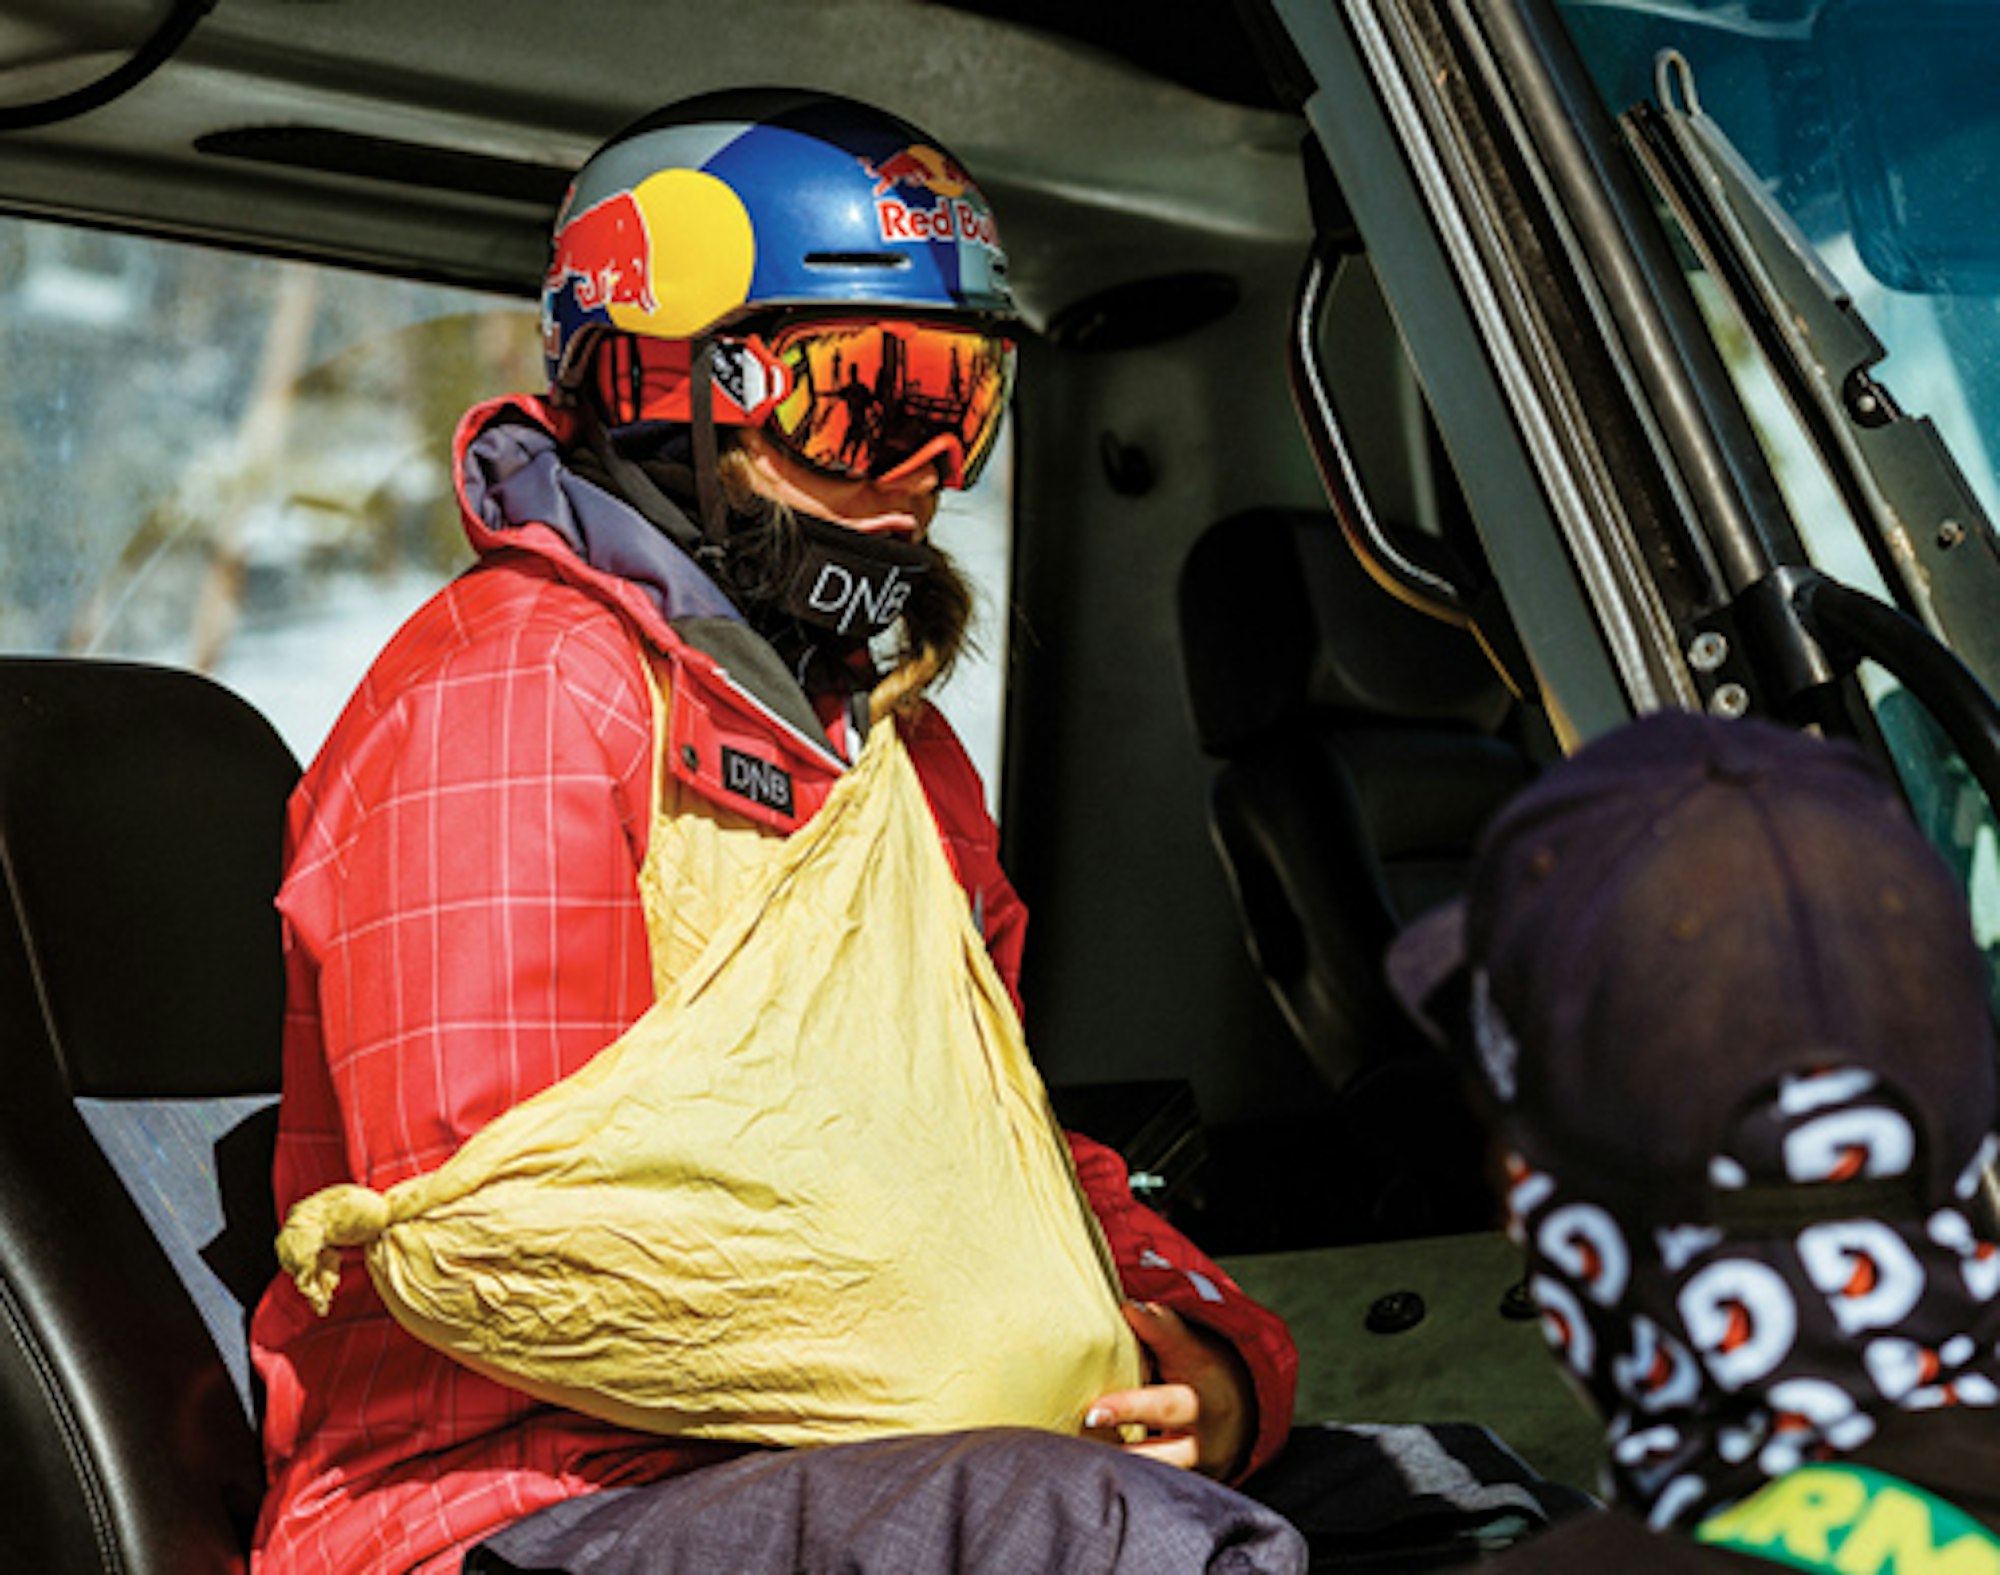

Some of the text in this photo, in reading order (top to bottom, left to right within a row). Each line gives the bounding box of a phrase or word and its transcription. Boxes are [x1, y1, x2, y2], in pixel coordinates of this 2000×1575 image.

[875, 198, 1001, 249] Red Bu
[808, 562, 911, 635] DNB
[730, 754, 790, 805] DNB
[1797, 1218, 1926, 1338] G
[1678, 1258, 1798, 1391] G
